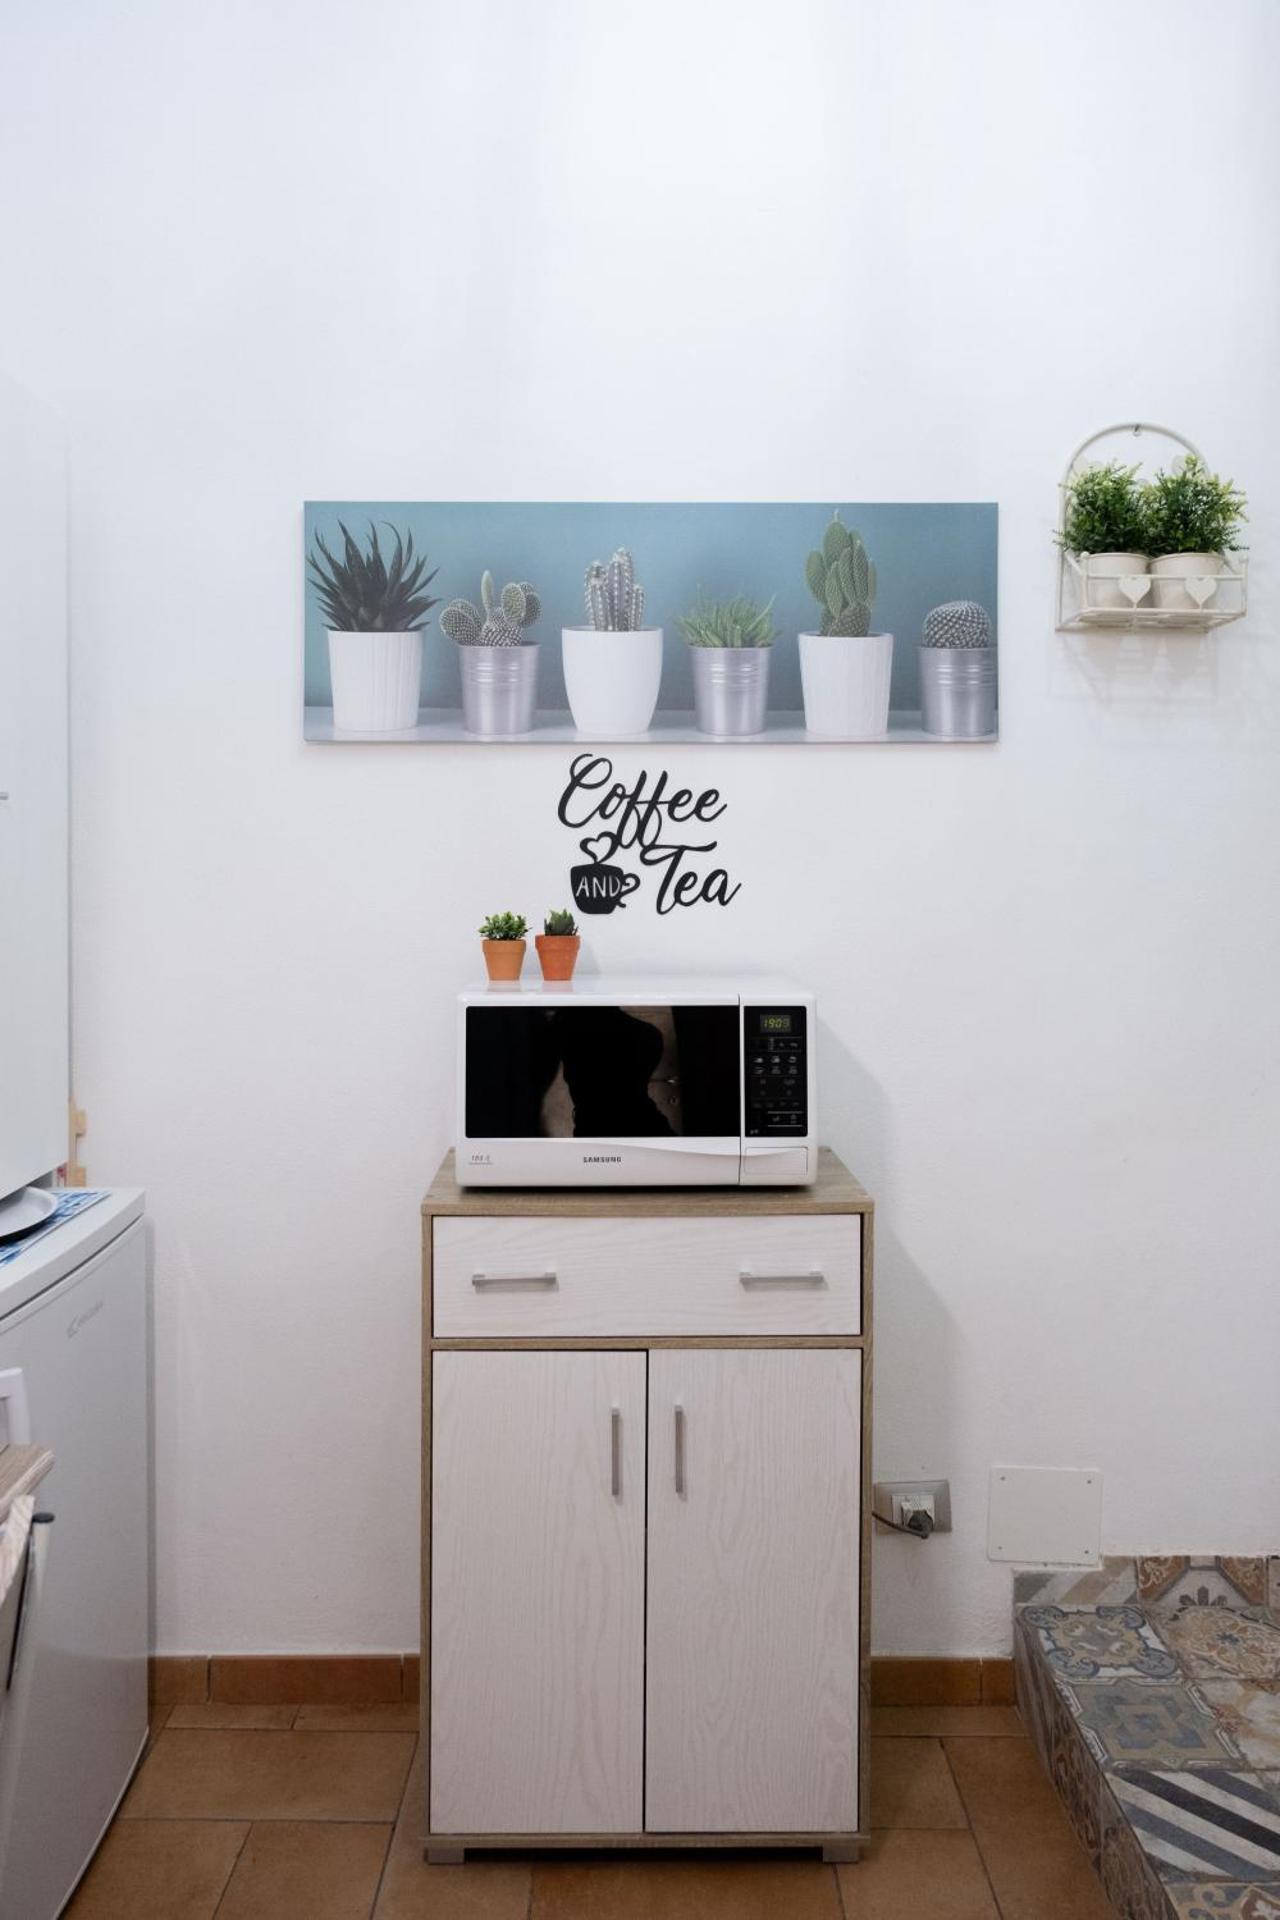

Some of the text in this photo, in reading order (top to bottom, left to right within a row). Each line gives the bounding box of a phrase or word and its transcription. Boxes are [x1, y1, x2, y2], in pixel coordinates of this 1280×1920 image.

[558, 753, 728, 849] Coffee
[575, 840, 742, 915] AND Tea
